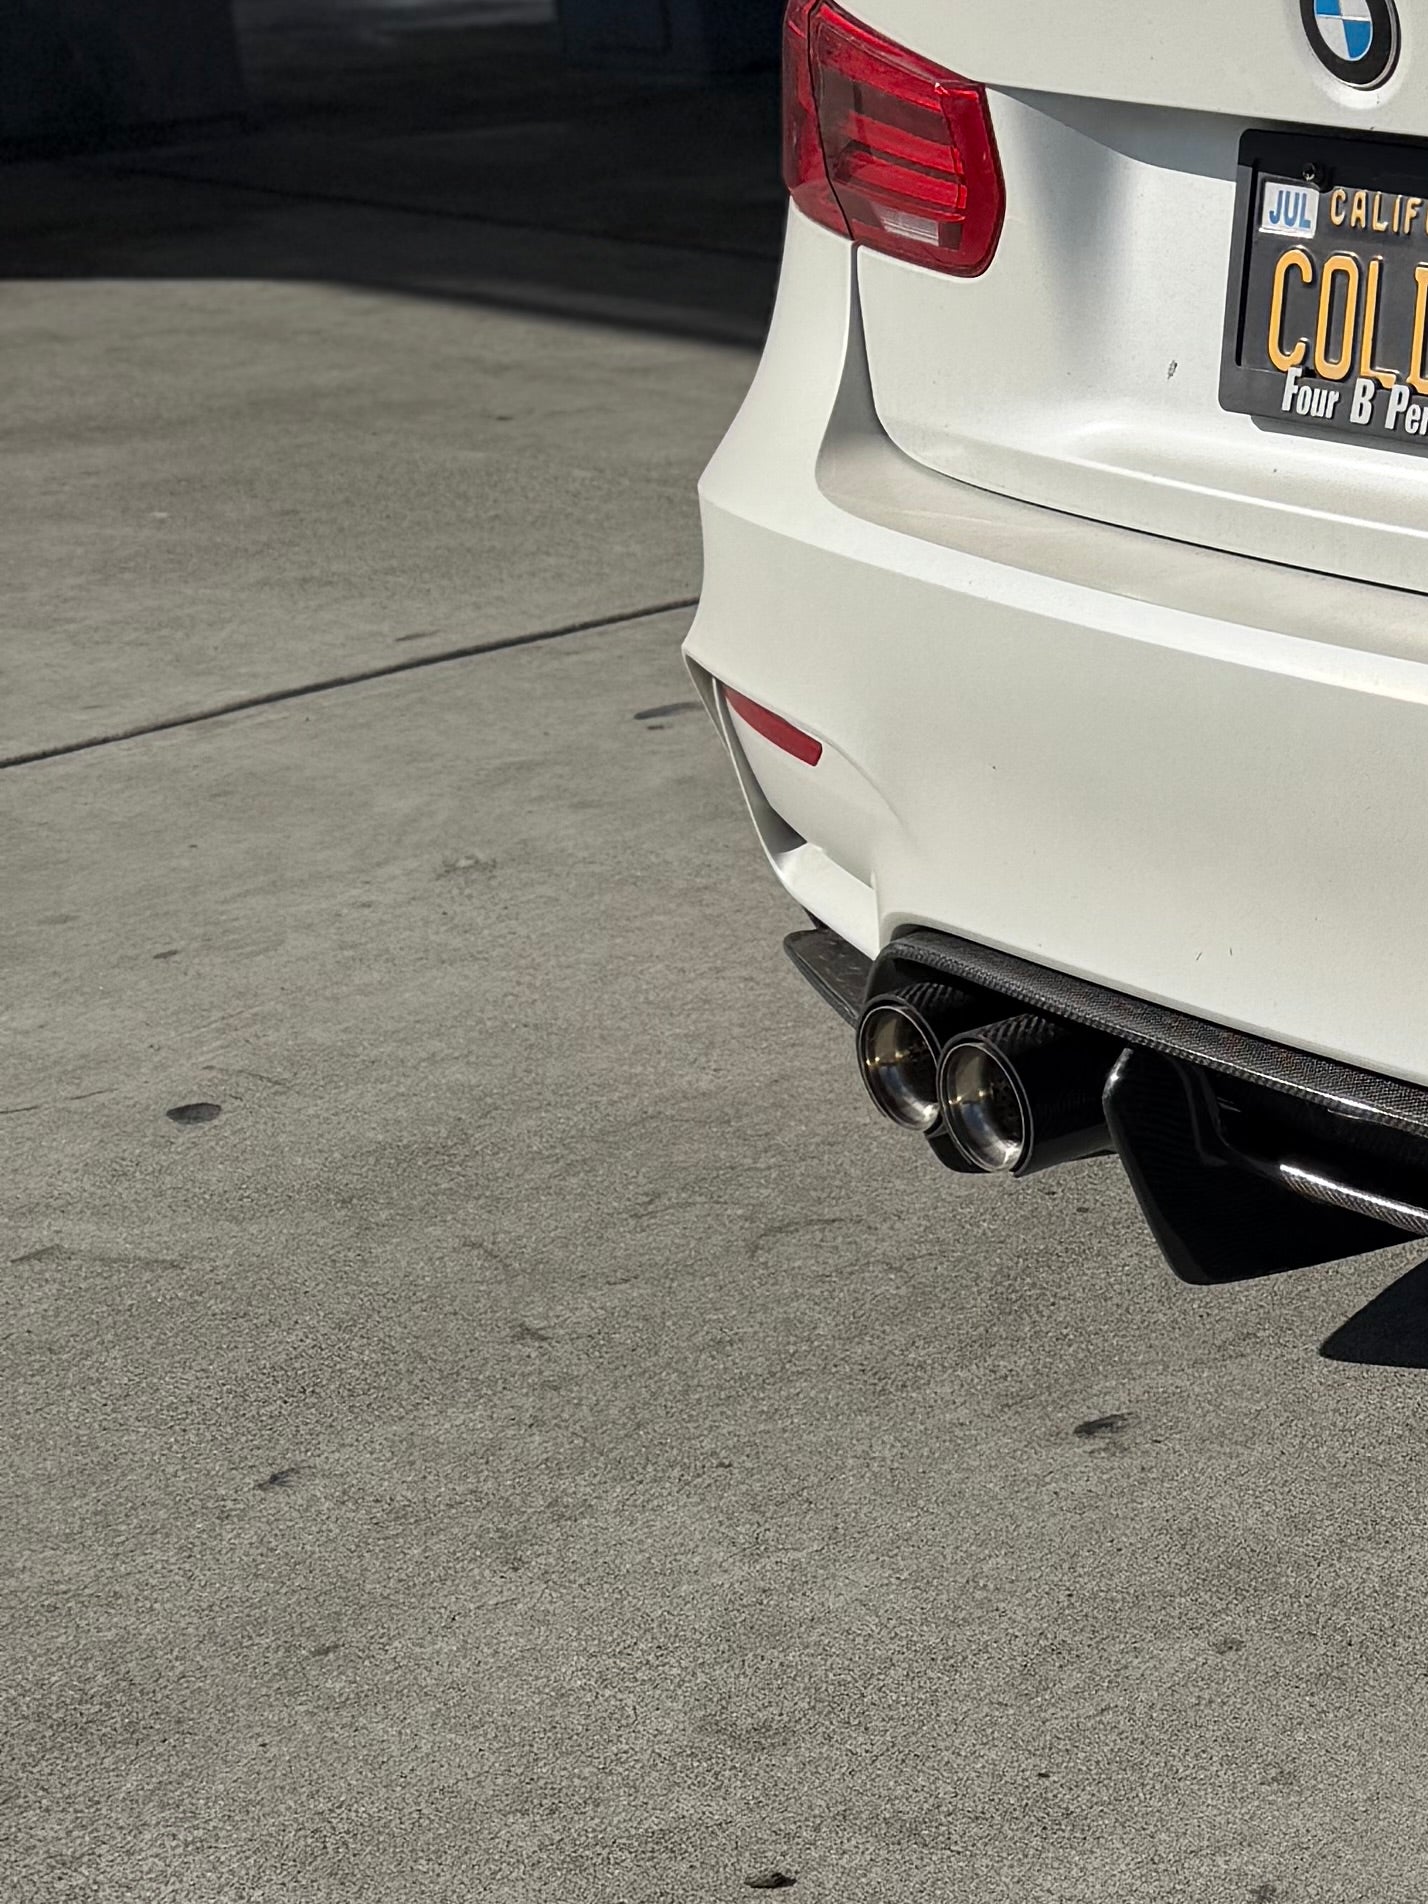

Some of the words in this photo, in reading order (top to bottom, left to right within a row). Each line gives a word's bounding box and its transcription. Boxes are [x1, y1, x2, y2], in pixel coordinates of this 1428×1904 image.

[1269, 190, 1312, 229] JUL
[1281, 367, 1340, 419] Four
[1350, 377, 1376, 425] B
